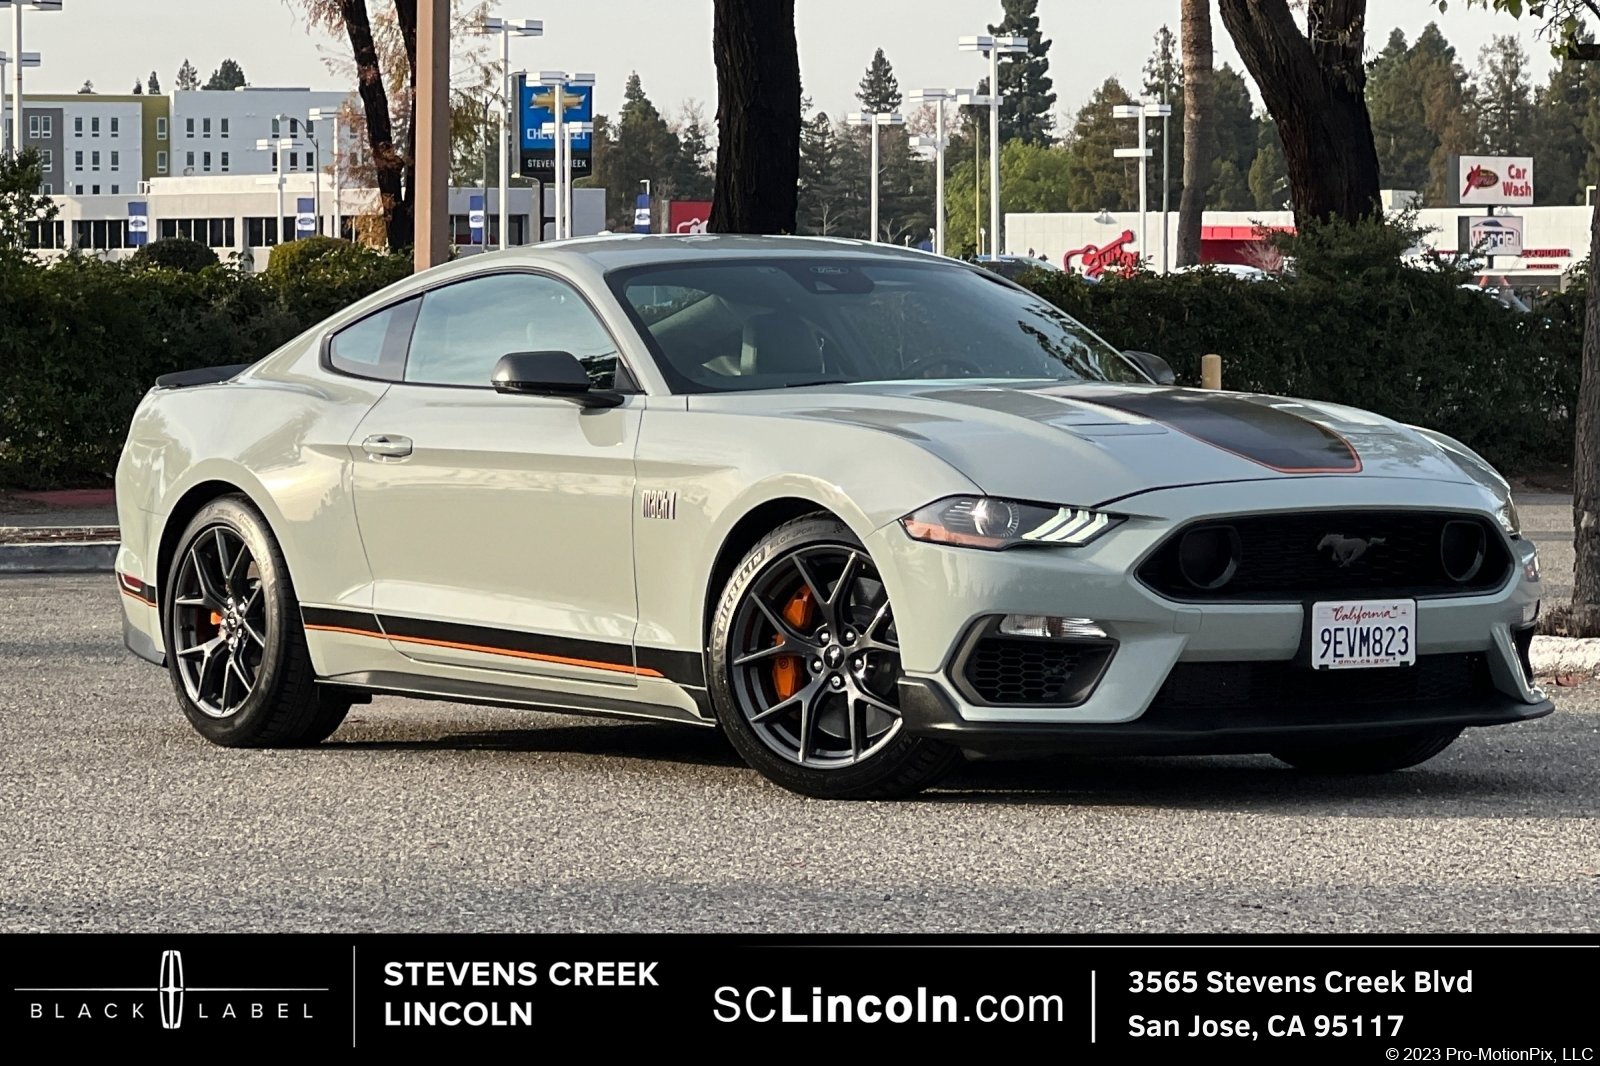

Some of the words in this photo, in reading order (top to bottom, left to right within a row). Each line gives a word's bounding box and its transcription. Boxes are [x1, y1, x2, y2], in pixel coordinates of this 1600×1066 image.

[527, 127, 587, 140] CHEVLET
[527, 159, 559, 168] STEVEN
[1508, 164, 1527, 179] Car
[1502, 181, 1532, 197] Wash
[717, 550, 764, 633] MICHELIN
[1332, 605, 1397, 624] California
[1320, 626, 1409, 659] 9EVM823
